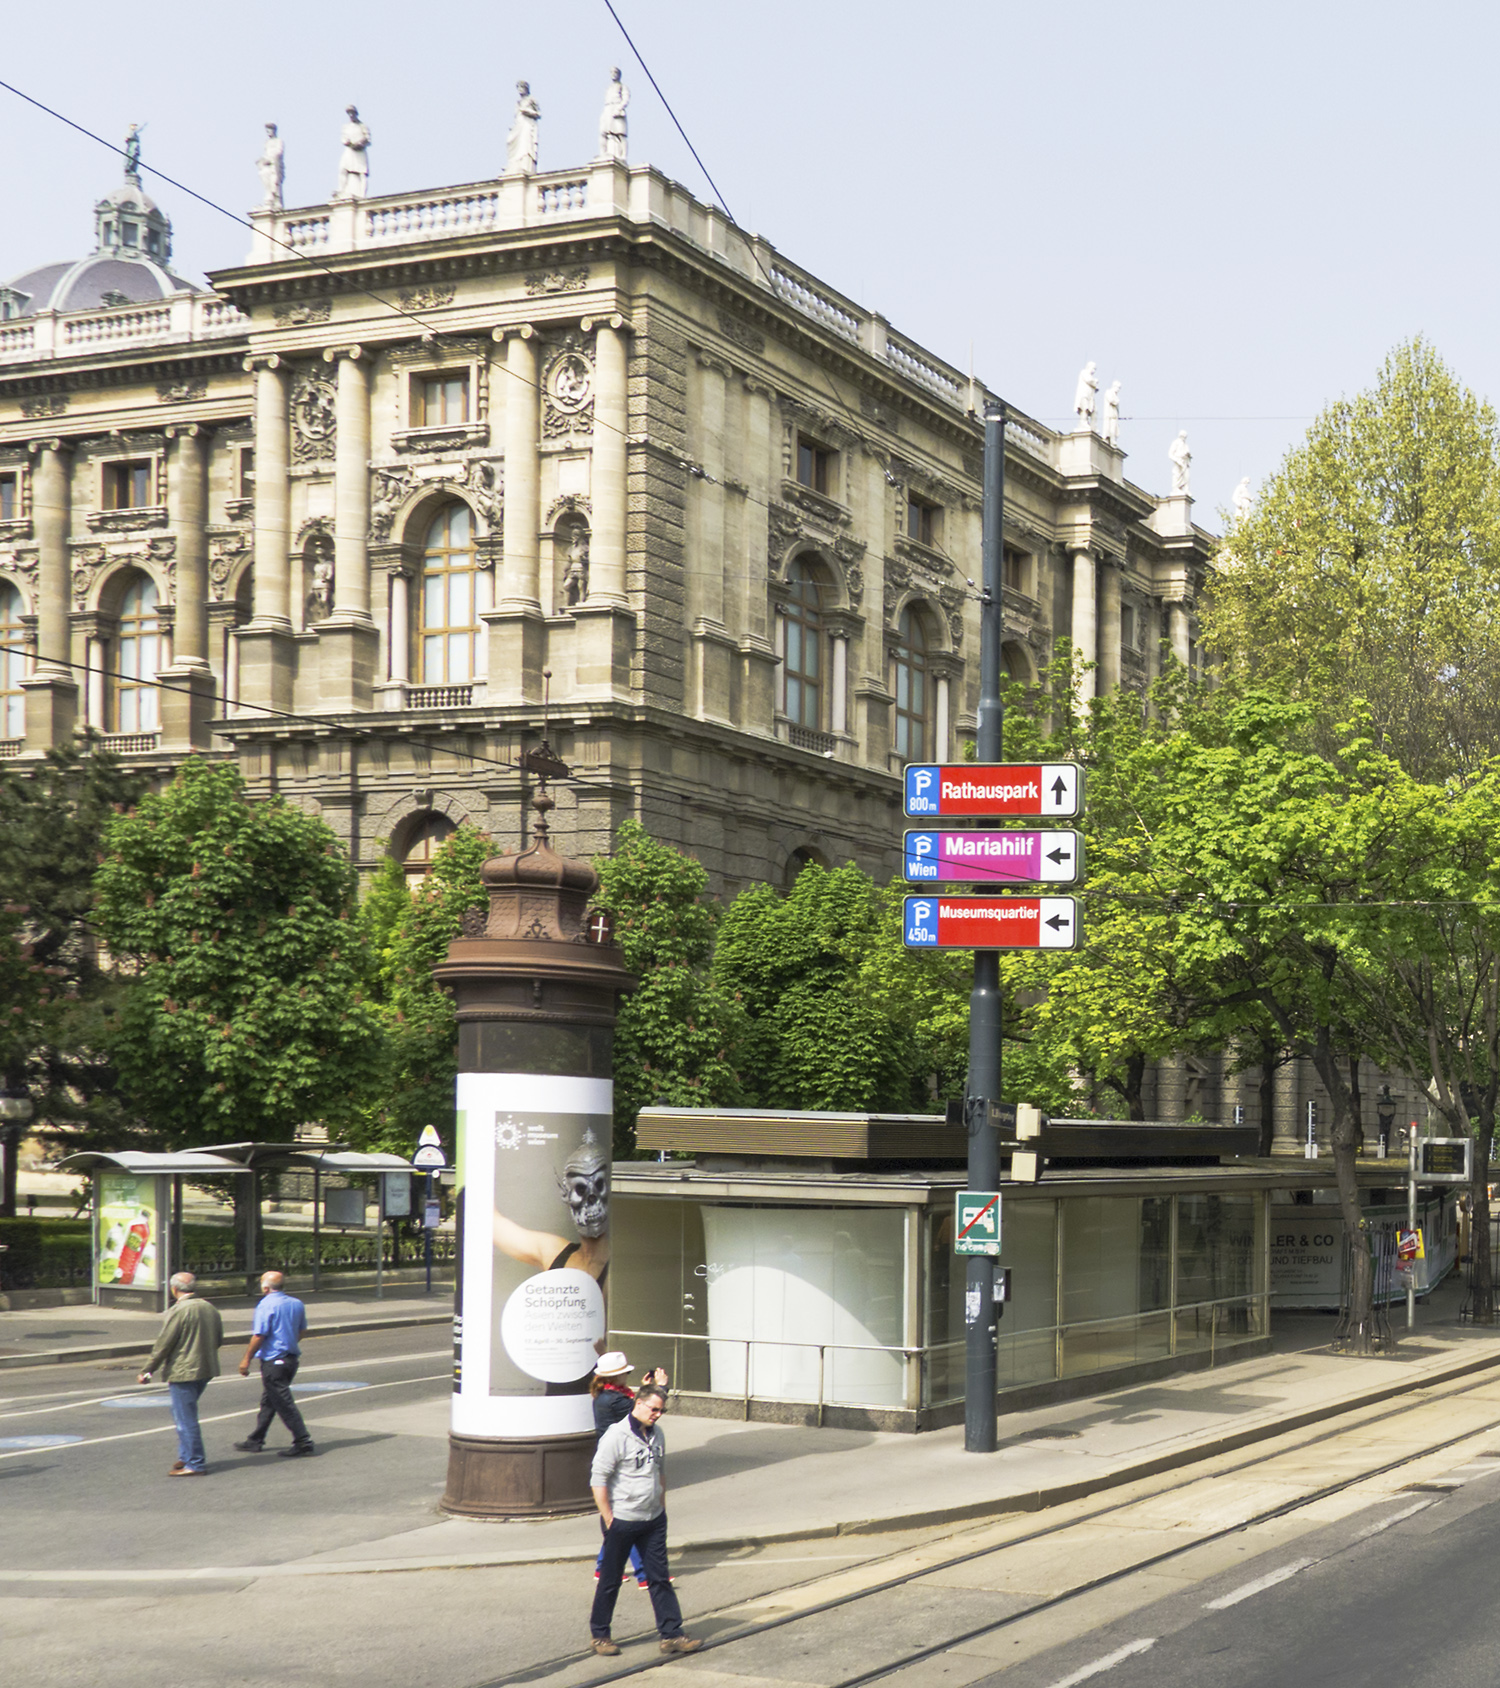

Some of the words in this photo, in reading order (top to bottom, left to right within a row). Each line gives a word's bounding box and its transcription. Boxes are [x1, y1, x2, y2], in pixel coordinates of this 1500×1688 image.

[942, 782, 1038, 802] Rathauspark
[945, 837, 1034, 855] Mariahilf
[908, 863, 937, 877] Wien
[939, 905, 1039, 921] Museumsquartier
[1300, 1235, 1309, 1247] &
[1313, 1234, 1334, 1246] CO
[1292, 1255, 1333, 1265] TIEFBAU
[525, 1284, 580, 1295] Getanzte
[525, 1296, 586, 1310] Schöpfung
